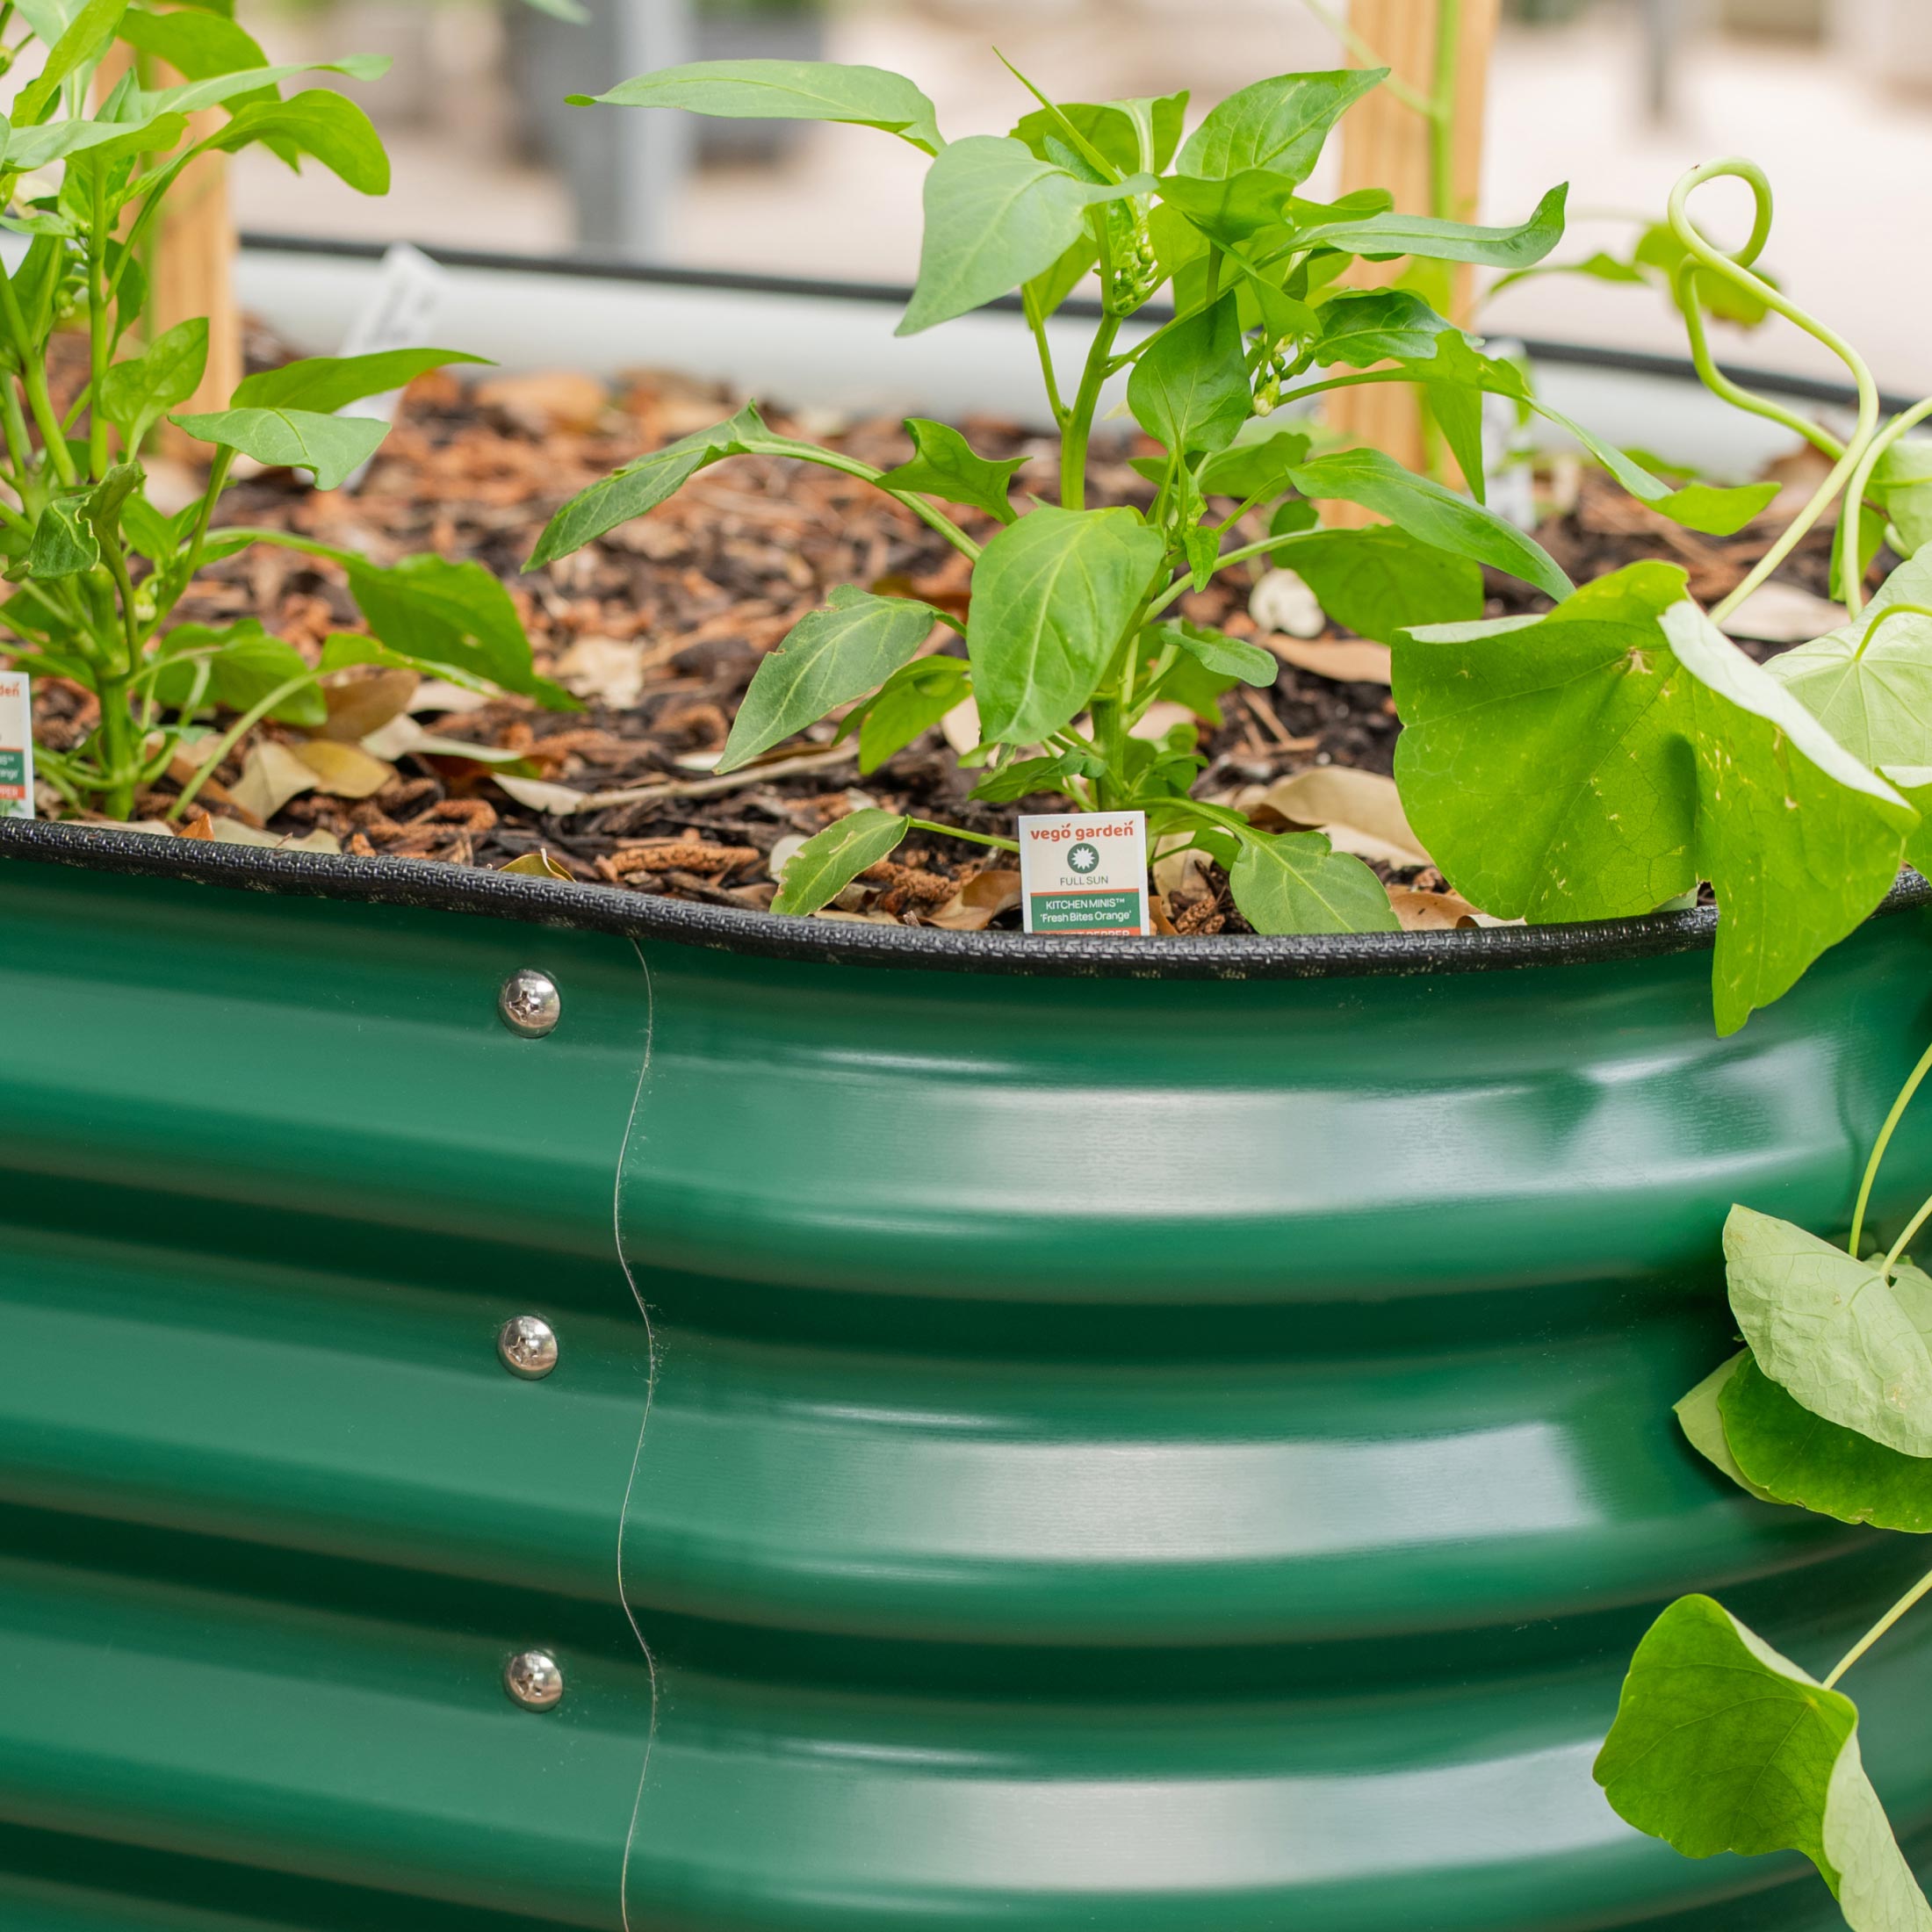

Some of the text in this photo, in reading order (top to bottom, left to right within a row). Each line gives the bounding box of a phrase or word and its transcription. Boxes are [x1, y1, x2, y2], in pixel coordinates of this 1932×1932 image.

[1076, 821, 1134, 841] garden
[1060, 876, 1109, 886] FULL SUN
[1046, 900, 1088, 910] KITCHEN
[1070, 912, 1093, 921] Bites
